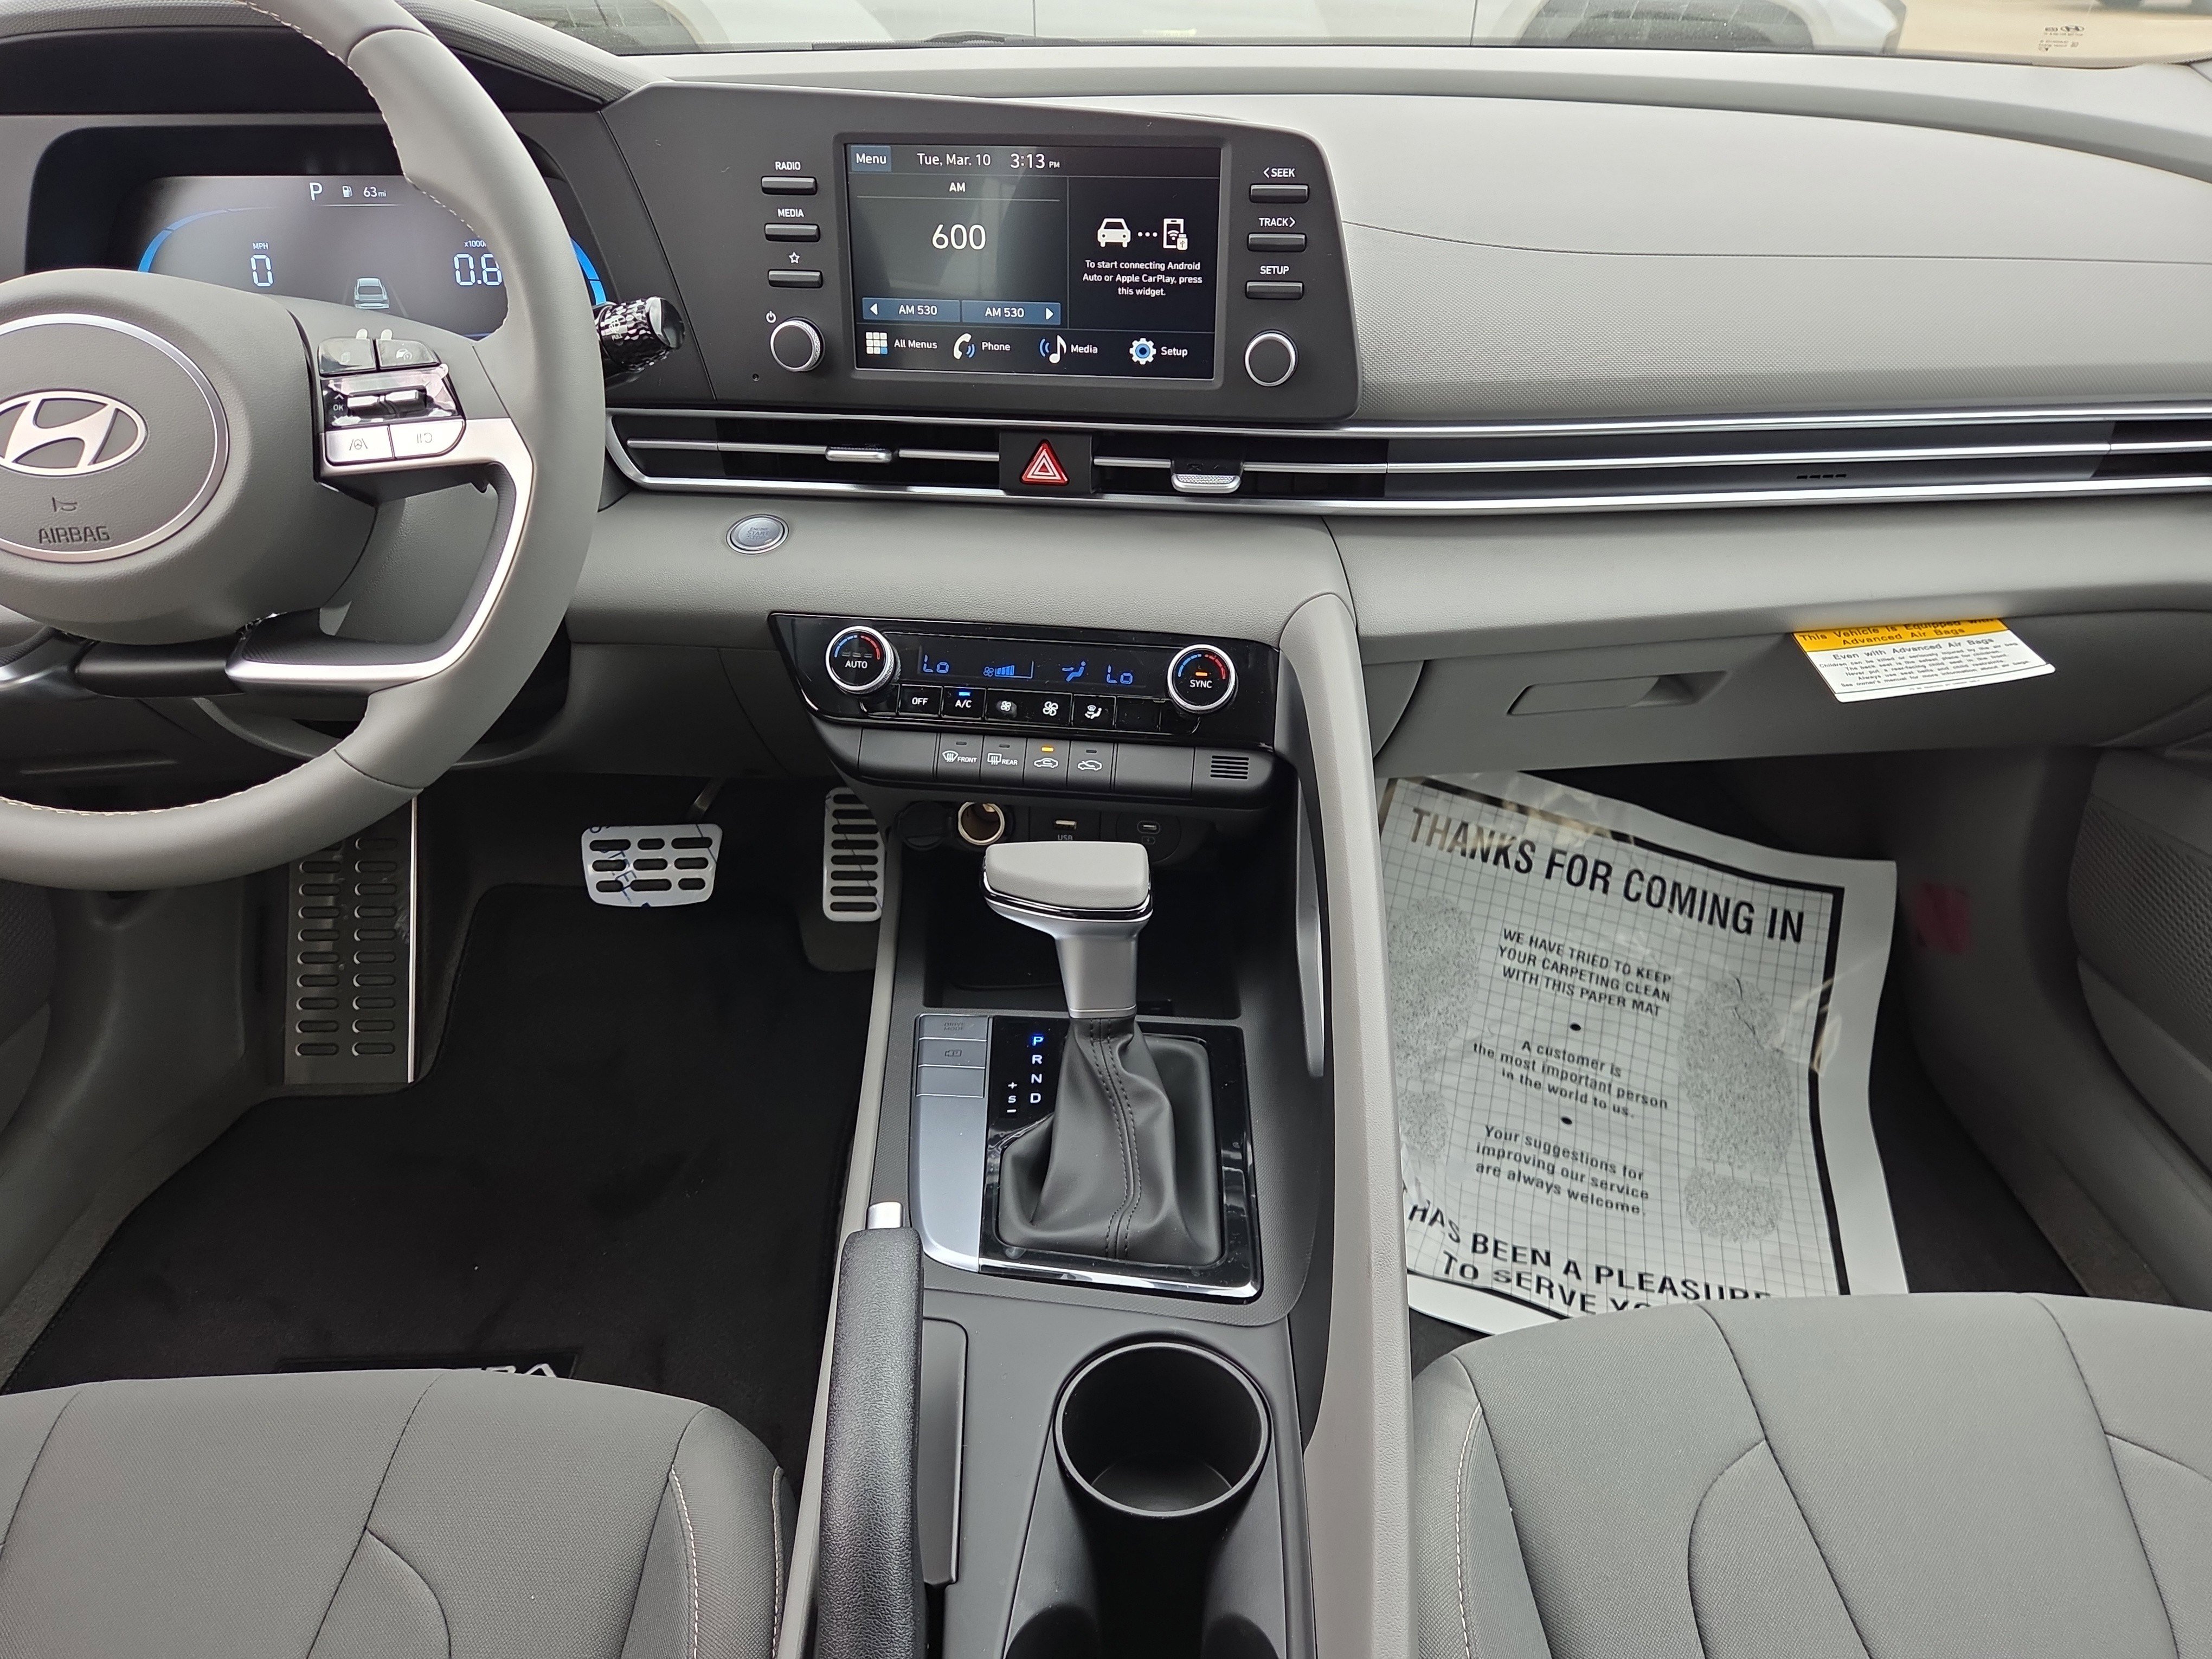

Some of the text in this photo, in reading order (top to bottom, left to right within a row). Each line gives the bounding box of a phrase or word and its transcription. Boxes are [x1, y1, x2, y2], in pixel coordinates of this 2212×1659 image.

[856, 153, 887, 164] Menu
[917, 153, 991, 166] Tue, Mar. 10
[1010, 153, 1045, 169] 3:13
[775, 162, 801, 170] RADIO
[309, 182, 323, 201] P
[949, 182, 966, 192] AM
[777, 208, 804, 217] MEDIA
[931, 224, 986, 250] 600
[250, 255, 273, 287] 0
[1085, 260, 1201, 271] To start connecting Android
[1260, 266, 1289, 275] SETUP
[1083, 273, 1102, 281] Auto
[1115, 274, 1140, 284] Apple
[1142, 274, 1176, 285] CarPlay,
[1179, 276, 1203, 285] press
[1118, 287, 1166, 298] this widget.
[899, 305, 937, 316] AM 530
[985, 307, 1025, 318] AM 530
[894, 339, 937, 349] All Menus
[981, 342, 1011, 351] Phone
[1071, 344, 1098, 353] Media
[1161, 347, 1188, 358] Setup
[39, 526, 110, 544] AIRBAG
[1798, 633, 1828, 641] This
[1833, 628, 1880, 638] Vehicle
[1843, 633, 1903, 646] Advanced
[1892, 644, 1942, 653] Advanced
[845, 660, 867, 669] AUTO
[1189, 679, 1212, 689] SYNC
[911, 697, 928, 705] OFF
[955, 699, 973, 709] A/C
[1411, 807, 1804, 943] THANKS FOR COMING IN
[1503, 928, 1671, 983] WE HAVE TRIED TO KEEP
[1499, 944, 1670, 1003] YOUR CARPETING CLEAN
[1502, 965, 1661, 1017] WITH THIS PAPER MAT
[1032, 1036, 1044, 1046] P
[1032, 1054, 1043, 1064] R
[1521, 1040, 1622, 1078] A customer is
[1031, 1073, 1042, 1084] N
[1473, 1041, 1668, 1109] the most important person
[1030, 1093, 1041, 1103] D
[1501, 1068, 1635, 1118] in the world to us.
[1008, 1095, 1017, 1103] S
[1485, 1124, 1644, 1180] Your suggestions for
[1476, 1142, 1649, 1200] improving our service
[1476, 1162, 1501, 1177] are
[1507, 1169, 1561, 1195] always
[1409, 1199, 1461, 1244] HAS
[1471, 1232, 1551, 1268] BEEN
[1562, 1259, 1581, 1281] A
[1443, 1249, 1480, 1280] TO
[1493, 1269, 1597, 1315] SERVE
